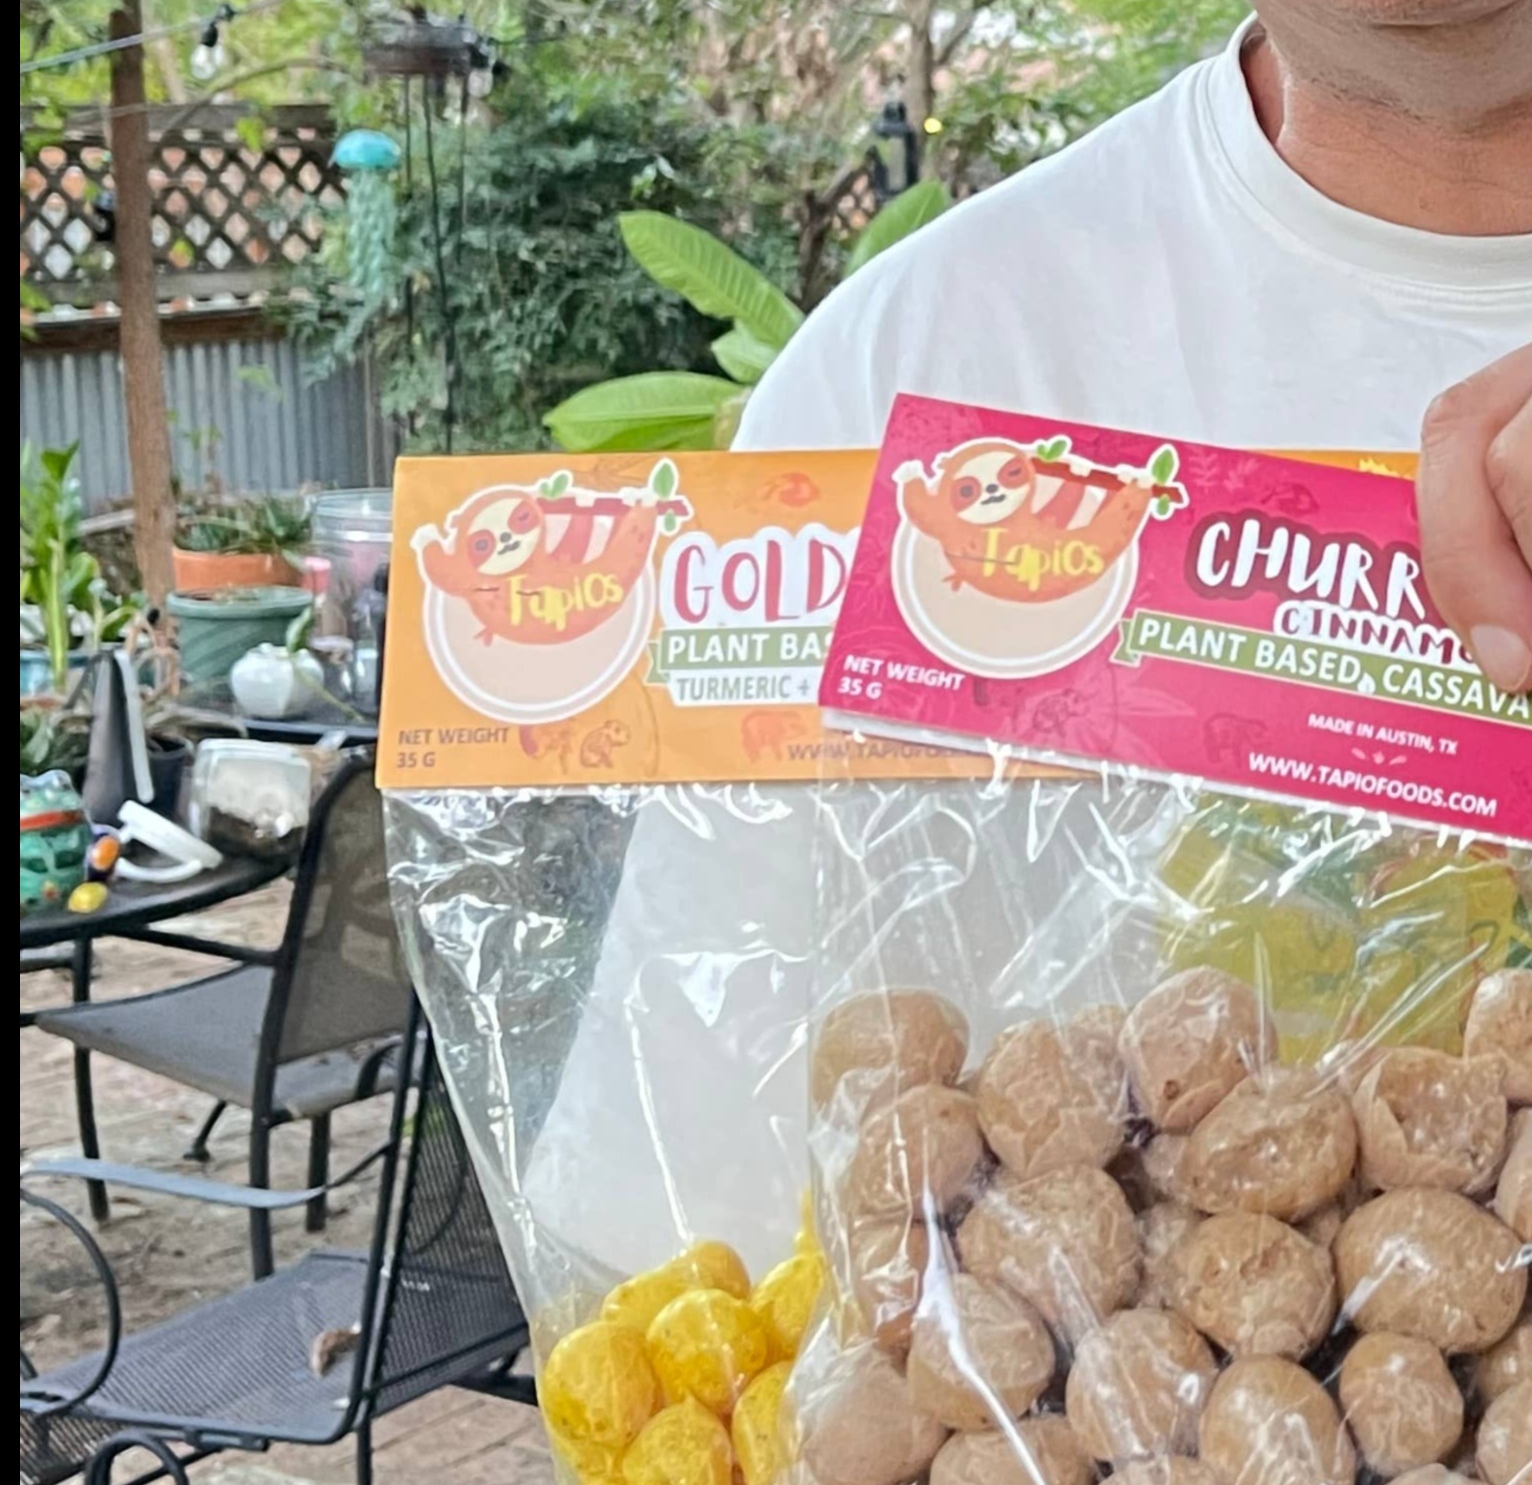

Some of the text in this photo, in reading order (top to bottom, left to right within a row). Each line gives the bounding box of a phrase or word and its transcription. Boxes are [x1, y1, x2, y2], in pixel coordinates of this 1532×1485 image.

[668, 634, 770, 664] PLANT
[843, 654, 966, 690] NET WEIGHT
[1139, 617, 1248, 663] PLANT
[1383, 664, 1529, 719] CASSAVA
[677, 675, 792, 701] TURMERIC
[837, 676, 882, 700] 35 G
[398, 727, 509, 745] NET WEIGHT
[1308, 713, 1458, 755] MADE IN AUSTIN, TX
[396, 751, 435, 768] 35 G
[1249, 752, 1497, 817] WWW.TAPIOFOODS.COM
